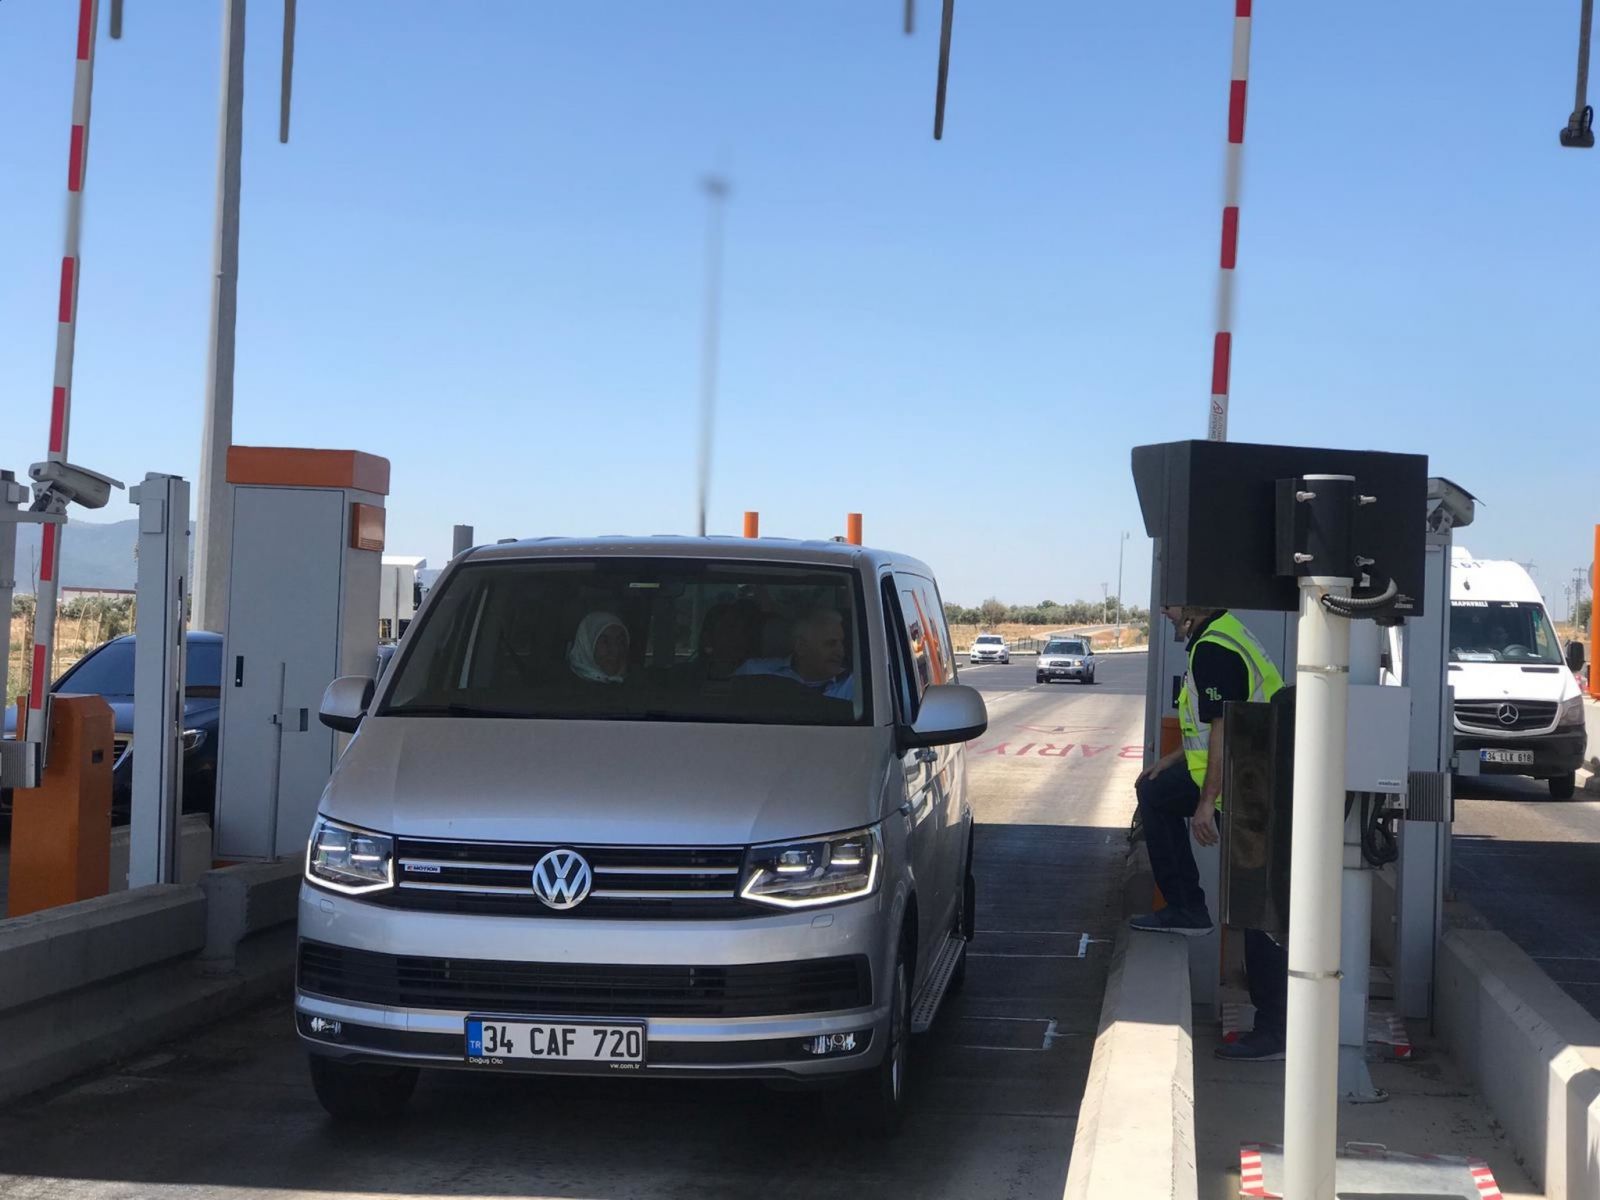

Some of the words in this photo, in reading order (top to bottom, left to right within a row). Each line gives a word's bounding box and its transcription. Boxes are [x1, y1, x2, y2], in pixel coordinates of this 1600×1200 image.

[469, 1040, 481, 1049] TR
[484, 1025, 514, 1054] 34
[530, 1027, 576, 1056] CAF
[593, 1029, 641, 1058] 720
[469, 1056, 490, 1065] Doğuş
